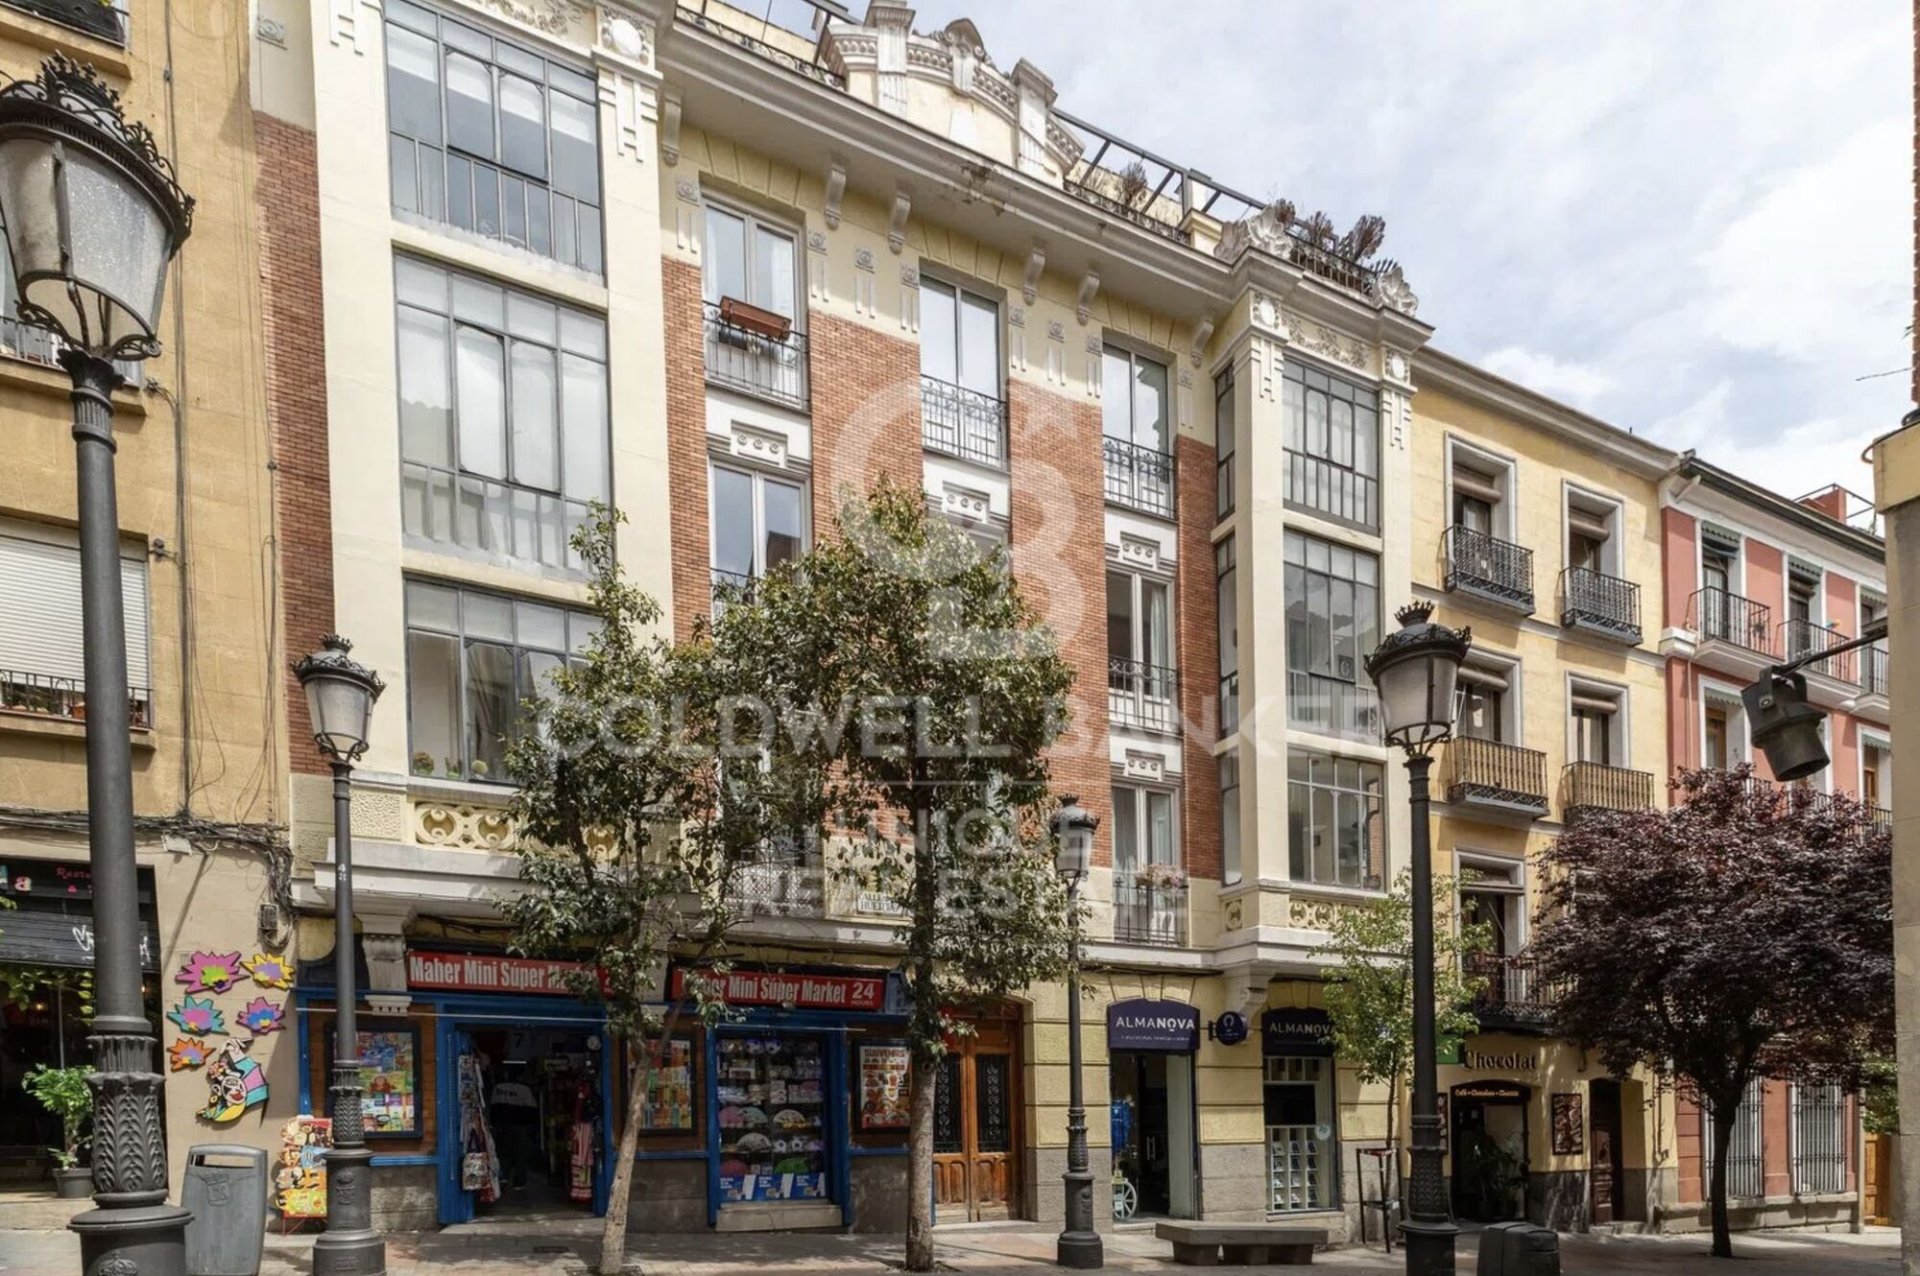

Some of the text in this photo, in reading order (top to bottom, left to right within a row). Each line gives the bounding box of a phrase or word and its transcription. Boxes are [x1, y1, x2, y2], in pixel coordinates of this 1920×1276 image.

[409, 956, 460, 984] Maher
[464, 959, 497, 985] Mini
[501, 961, 544, 989] Súper
[729, 976, 758, 999] Mini
[760, 977, 799, 1003] Súper
[802, 979, 847, 1003] Market
[852, 981, 874, 999] 24
[1115, 1016, 1195, 1032] ALMANOVA
[1464, 1050, 1537, 1070] Chocolat
